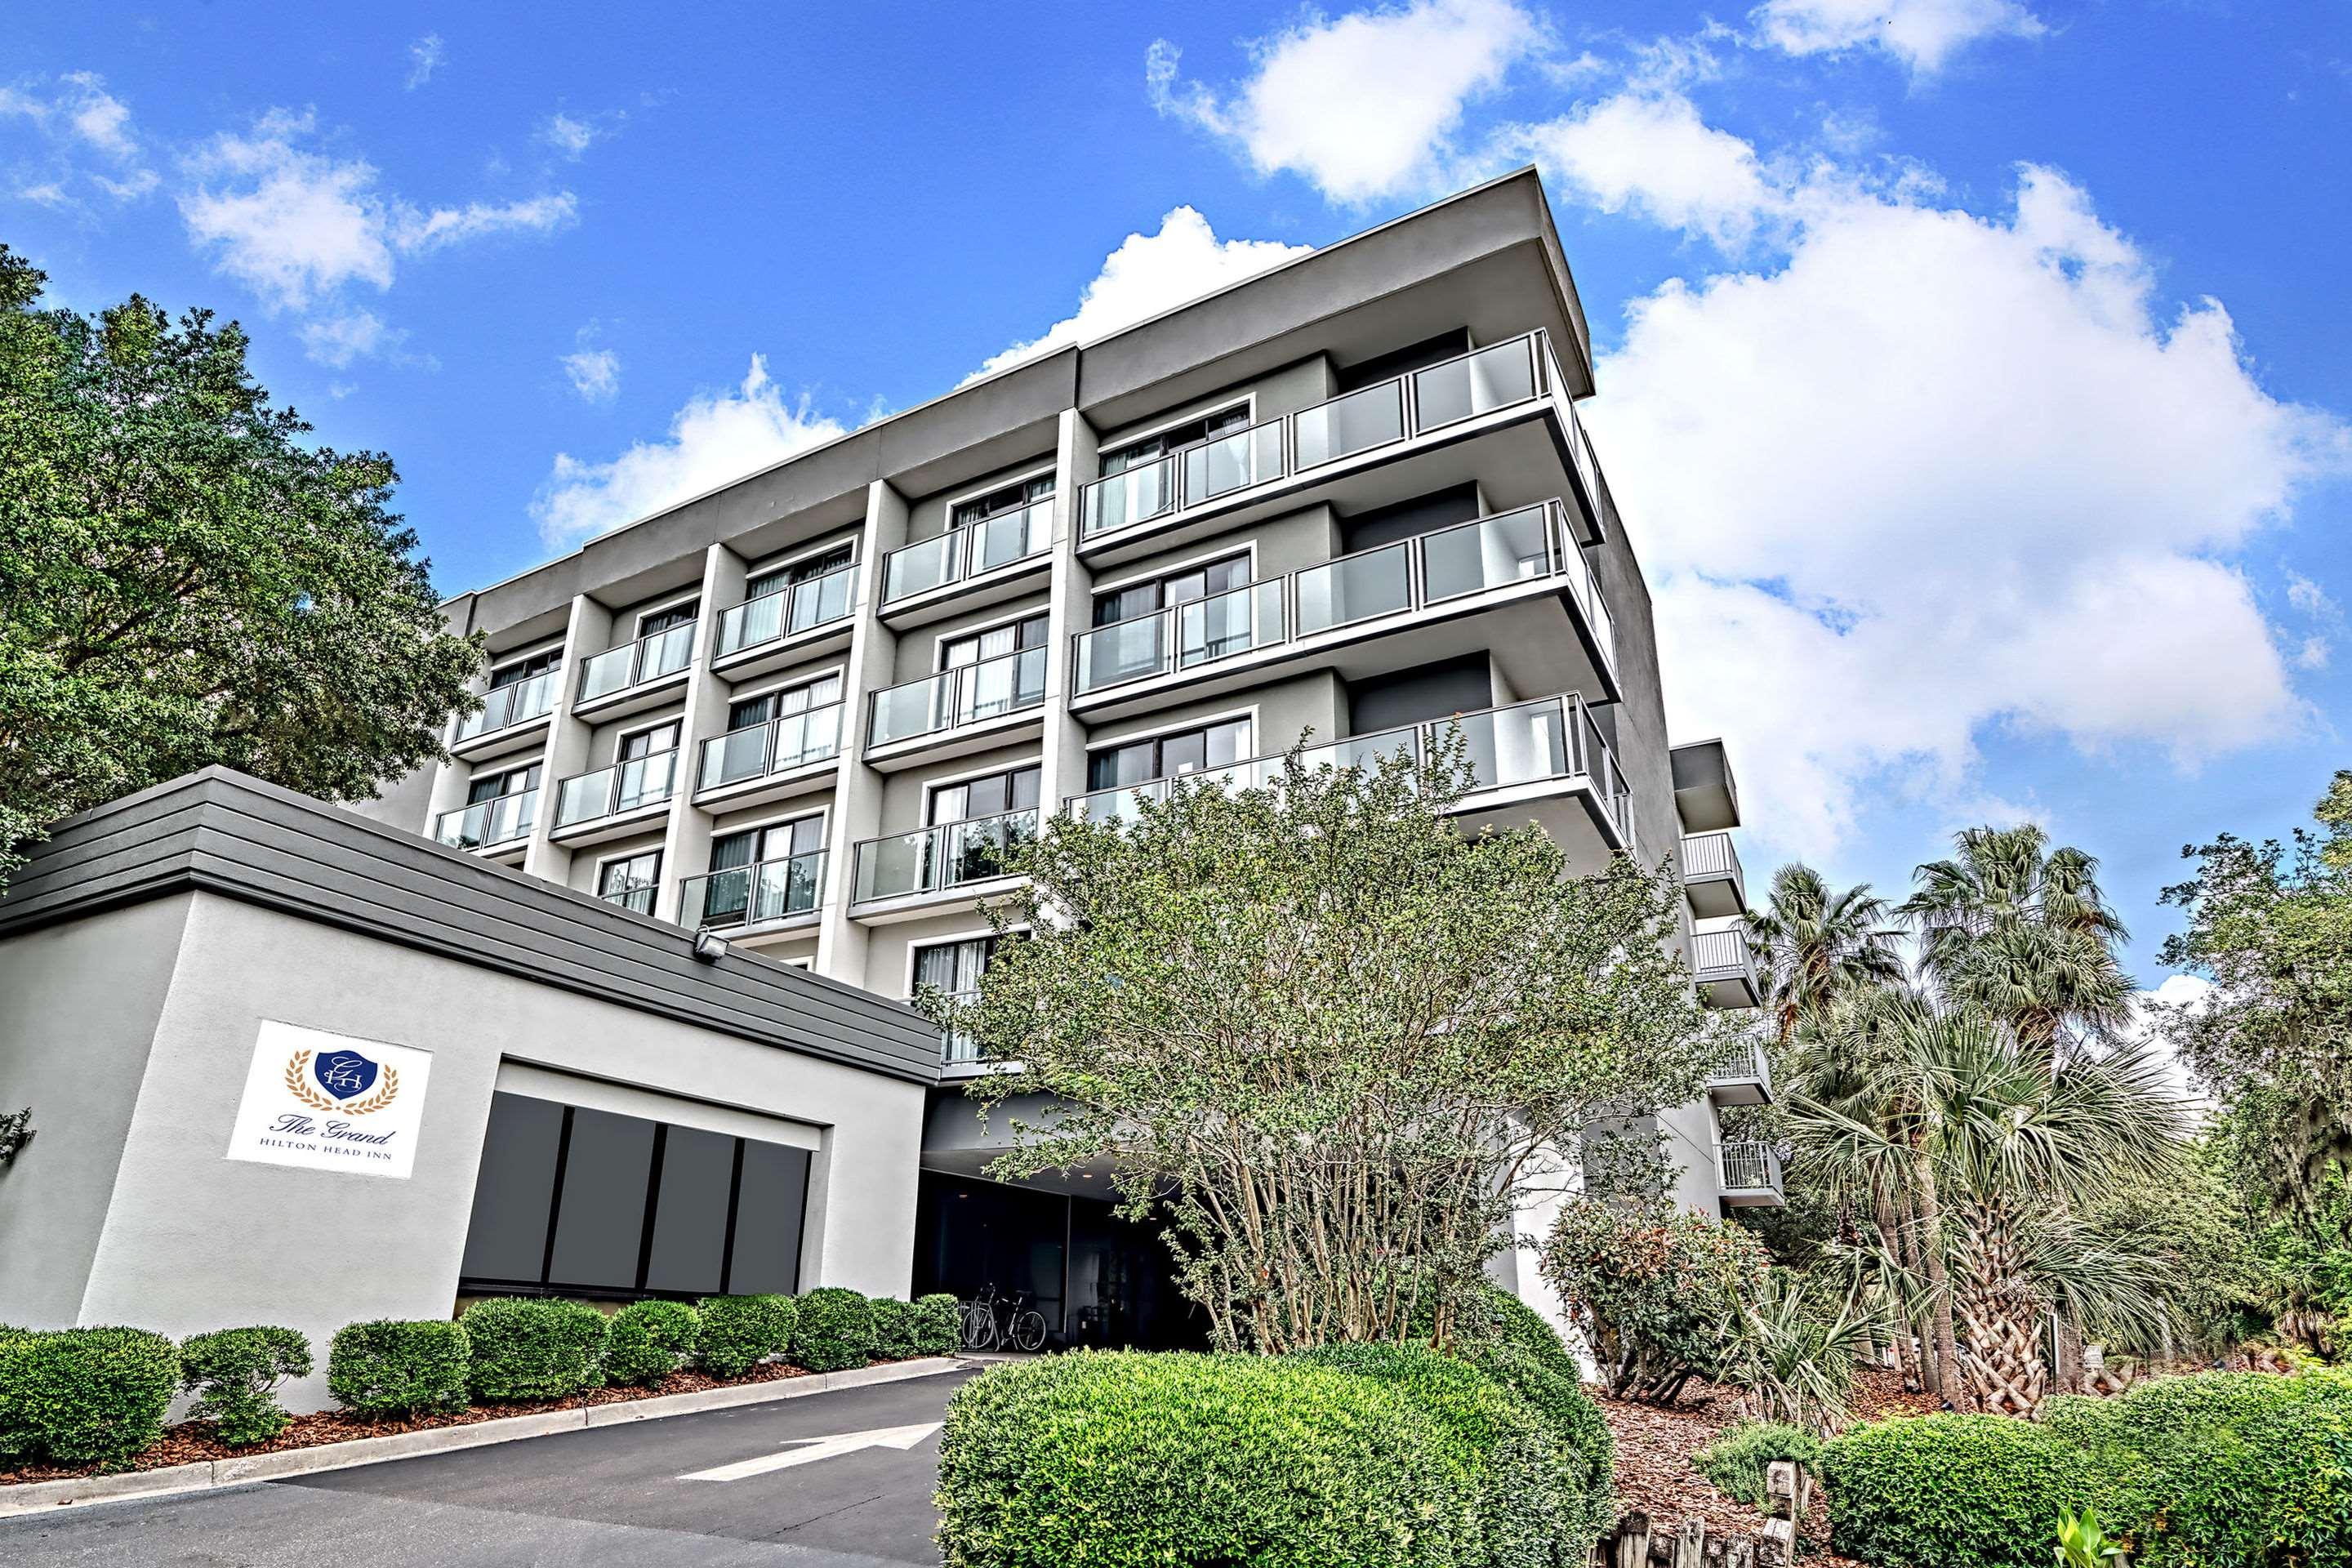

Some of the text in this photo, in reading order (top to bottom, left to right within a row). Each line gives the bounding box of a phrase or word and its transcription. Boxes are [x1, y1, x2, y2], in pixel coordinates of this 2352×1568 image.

[269, 1114, 397, 1145] The Grand
[260, 1138, 392, 1160] HILTON HEAD INN
